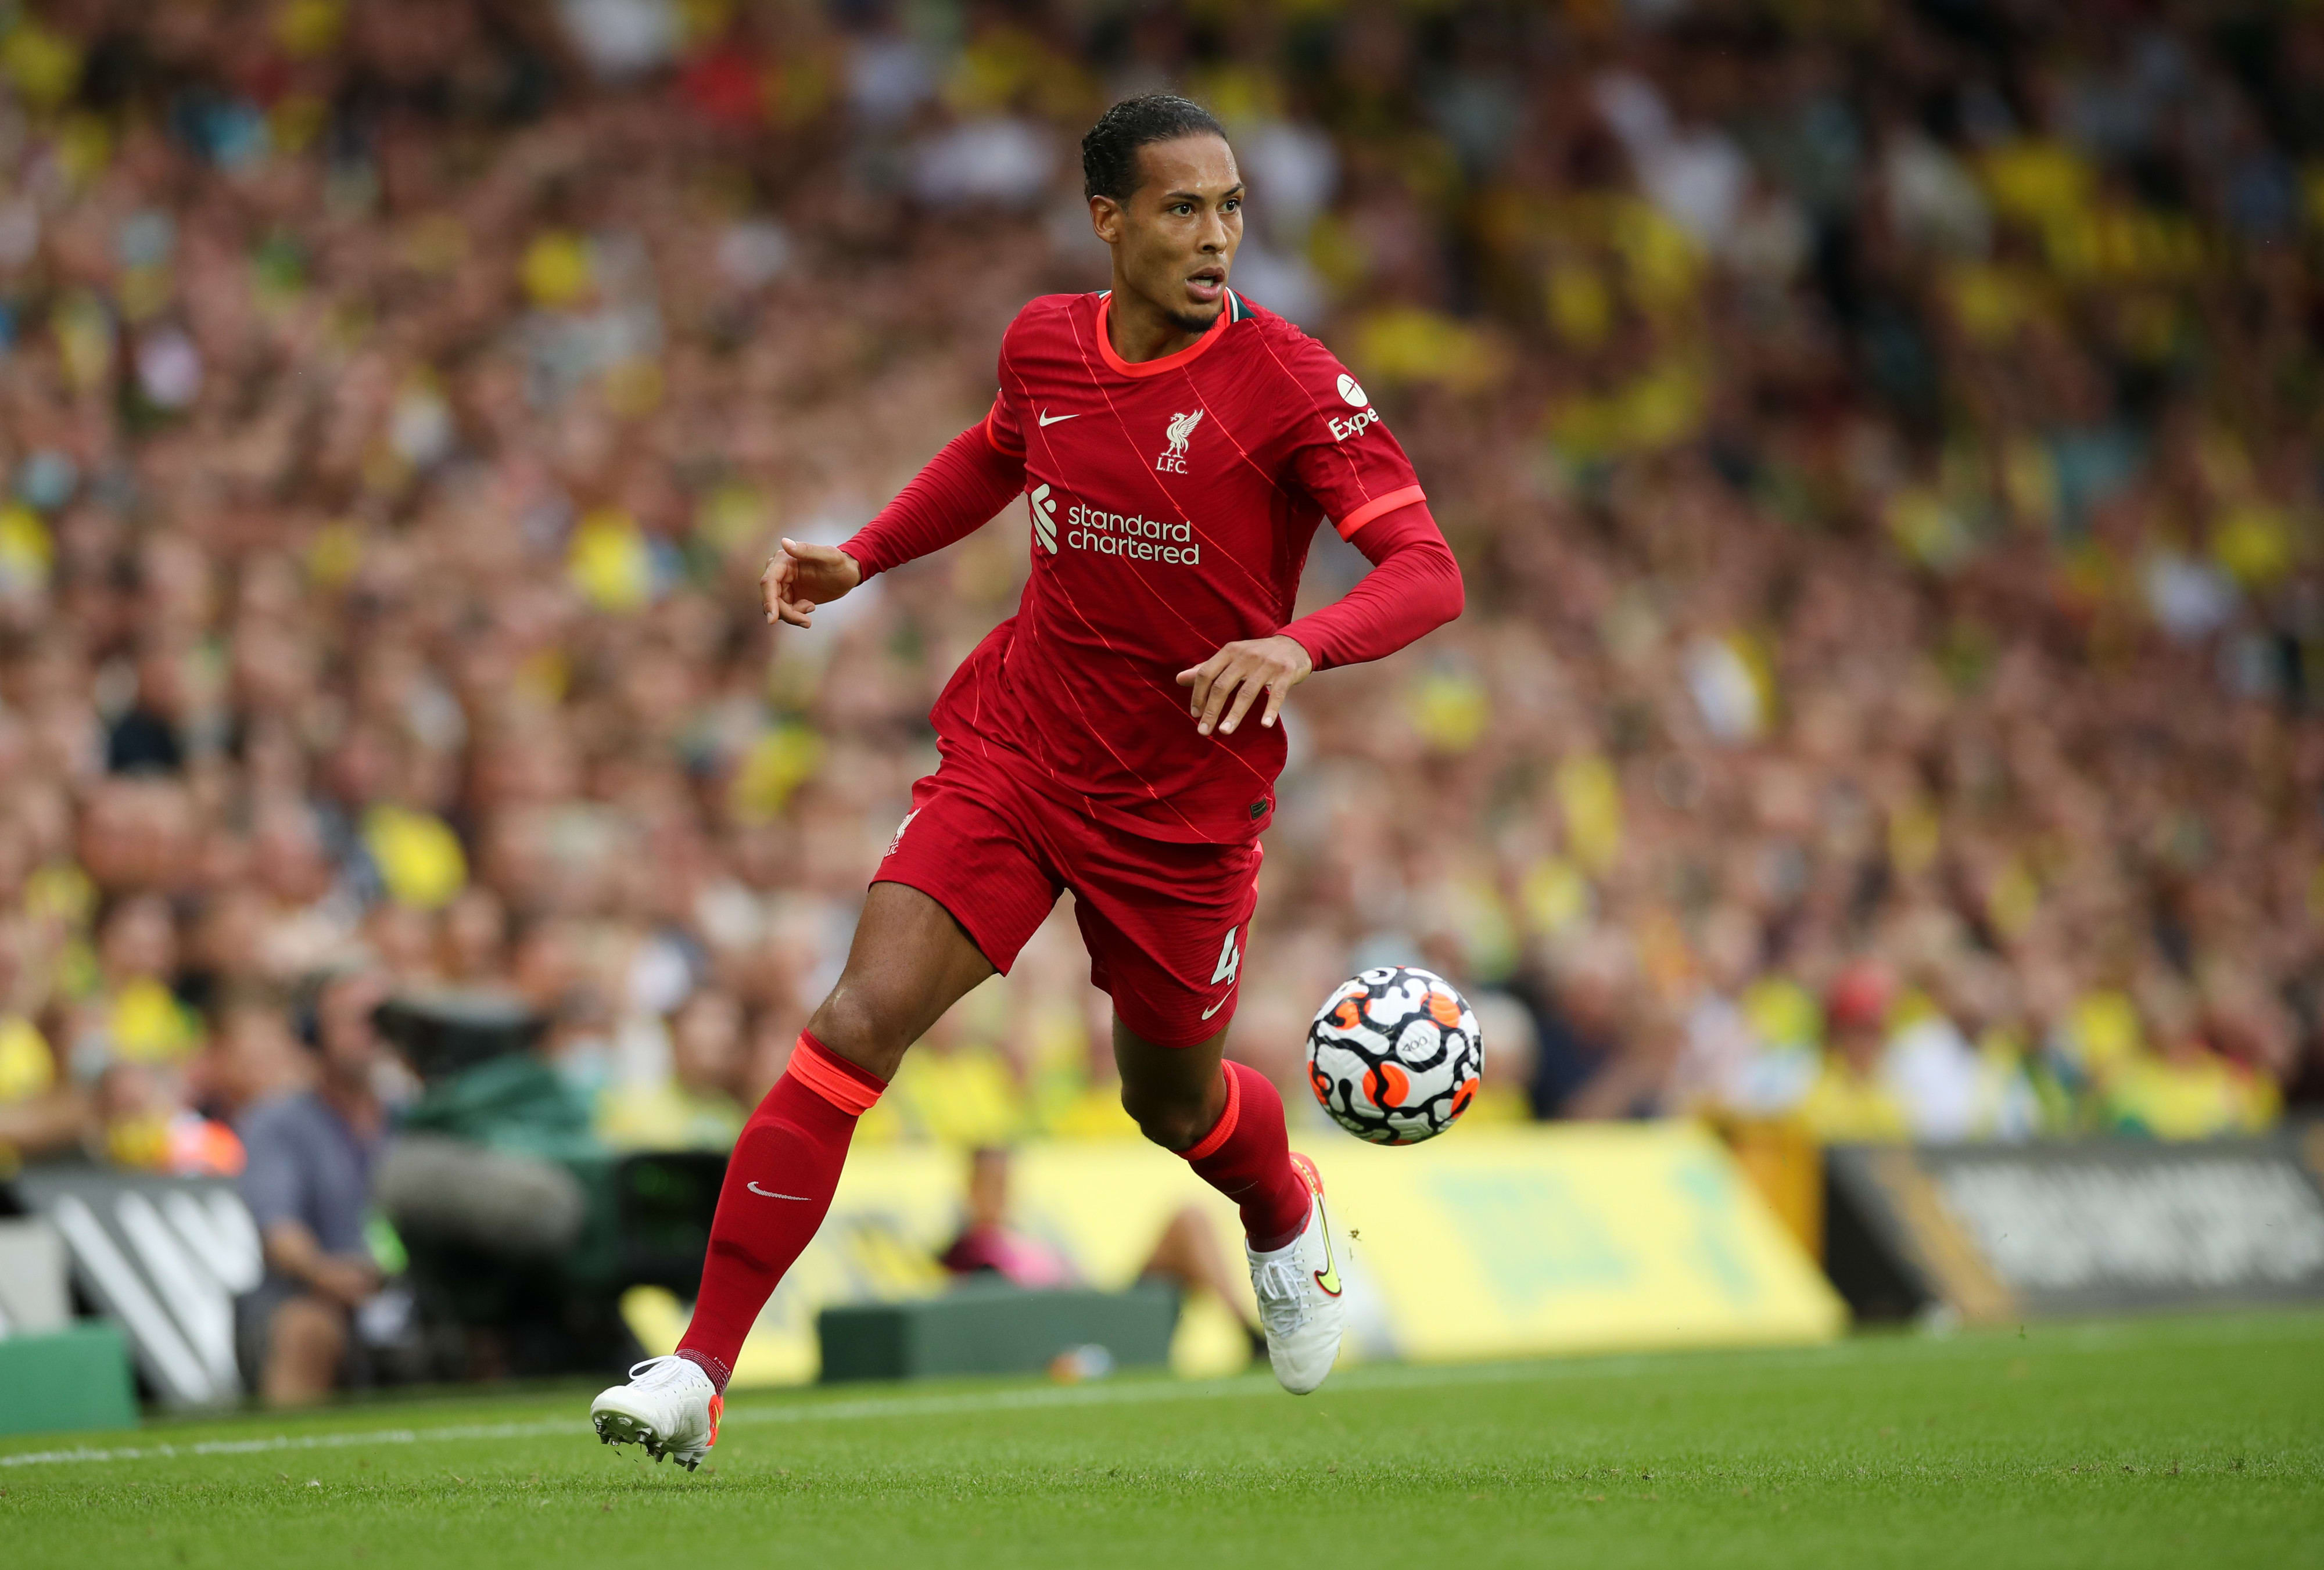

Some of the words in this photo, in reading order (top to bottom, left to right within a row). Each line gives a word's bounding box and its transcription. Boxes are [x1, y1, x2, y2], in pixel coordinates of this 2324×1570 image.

[1068, 504, 1190, 542] standard
[1068, 527, 1199, 565] chartered
[1210, 925, 1240, 986] 4
